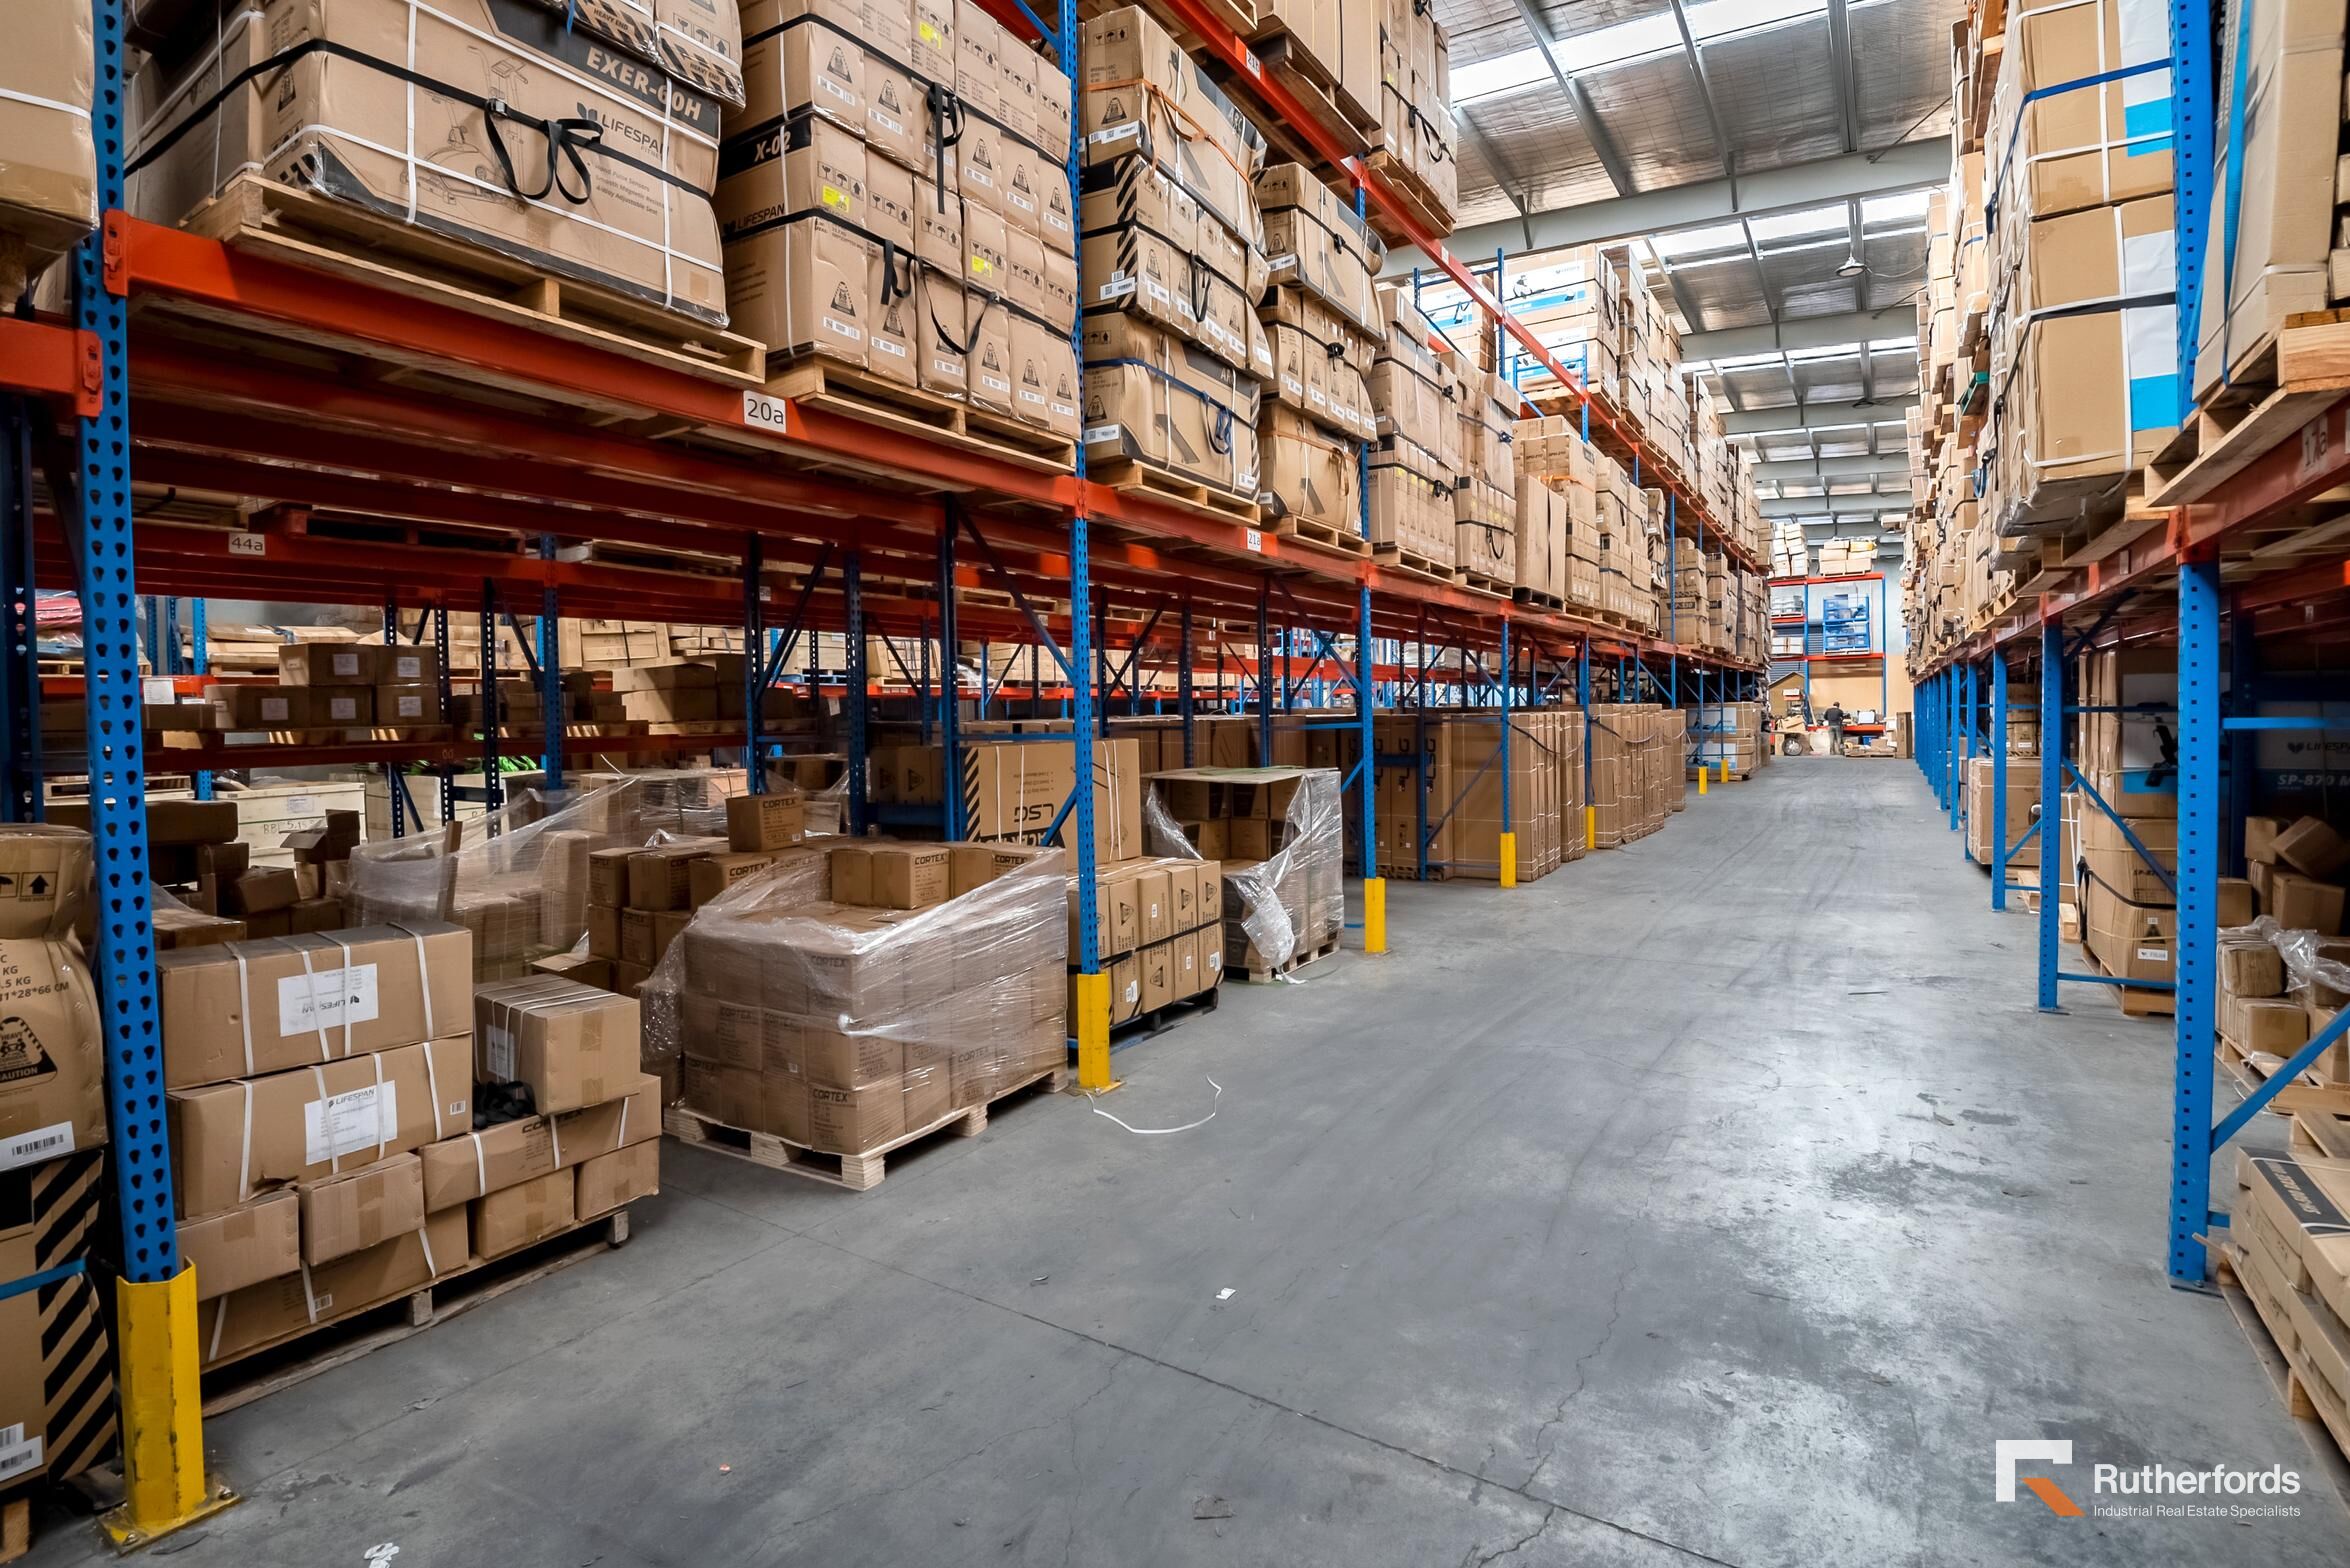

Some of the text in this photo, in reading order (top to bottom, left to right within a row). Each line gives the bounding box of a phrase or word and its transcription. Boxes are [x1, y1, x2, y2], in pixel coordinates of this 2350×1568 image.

[593, 7, 629, 31] HEAVY END
[689, 62, 721, 82] HEAVY END
[586, 46, 702, 122] EXER-60H
[754, 130, 792, 162] X-02
[737, 203, 786, 230] LIFESPAN
[747, 398, 784, 424] 20a
[231, 536, 264, 552] 44a
[1248, 532, 1260, 546] 21a
[762, 798, 796, 809] CORTEX
[1014, 803, 1054, 823] LSG
[914, 853, 946, 865] CORTEX
[994, 854, 1028, 865] CORTEX
[811, 954, 847, 968] CORTEX
[2, 965, 19, 976] KG
[15, 976, 32, 987] KG
[1, 1031, 23, 1041] HEAVY
[0, 1067, 39, 1081] AUTION
[335, 1088, 375, 1105] LIFESPAN
[812, 1088, 849, 1102] CORTEX
